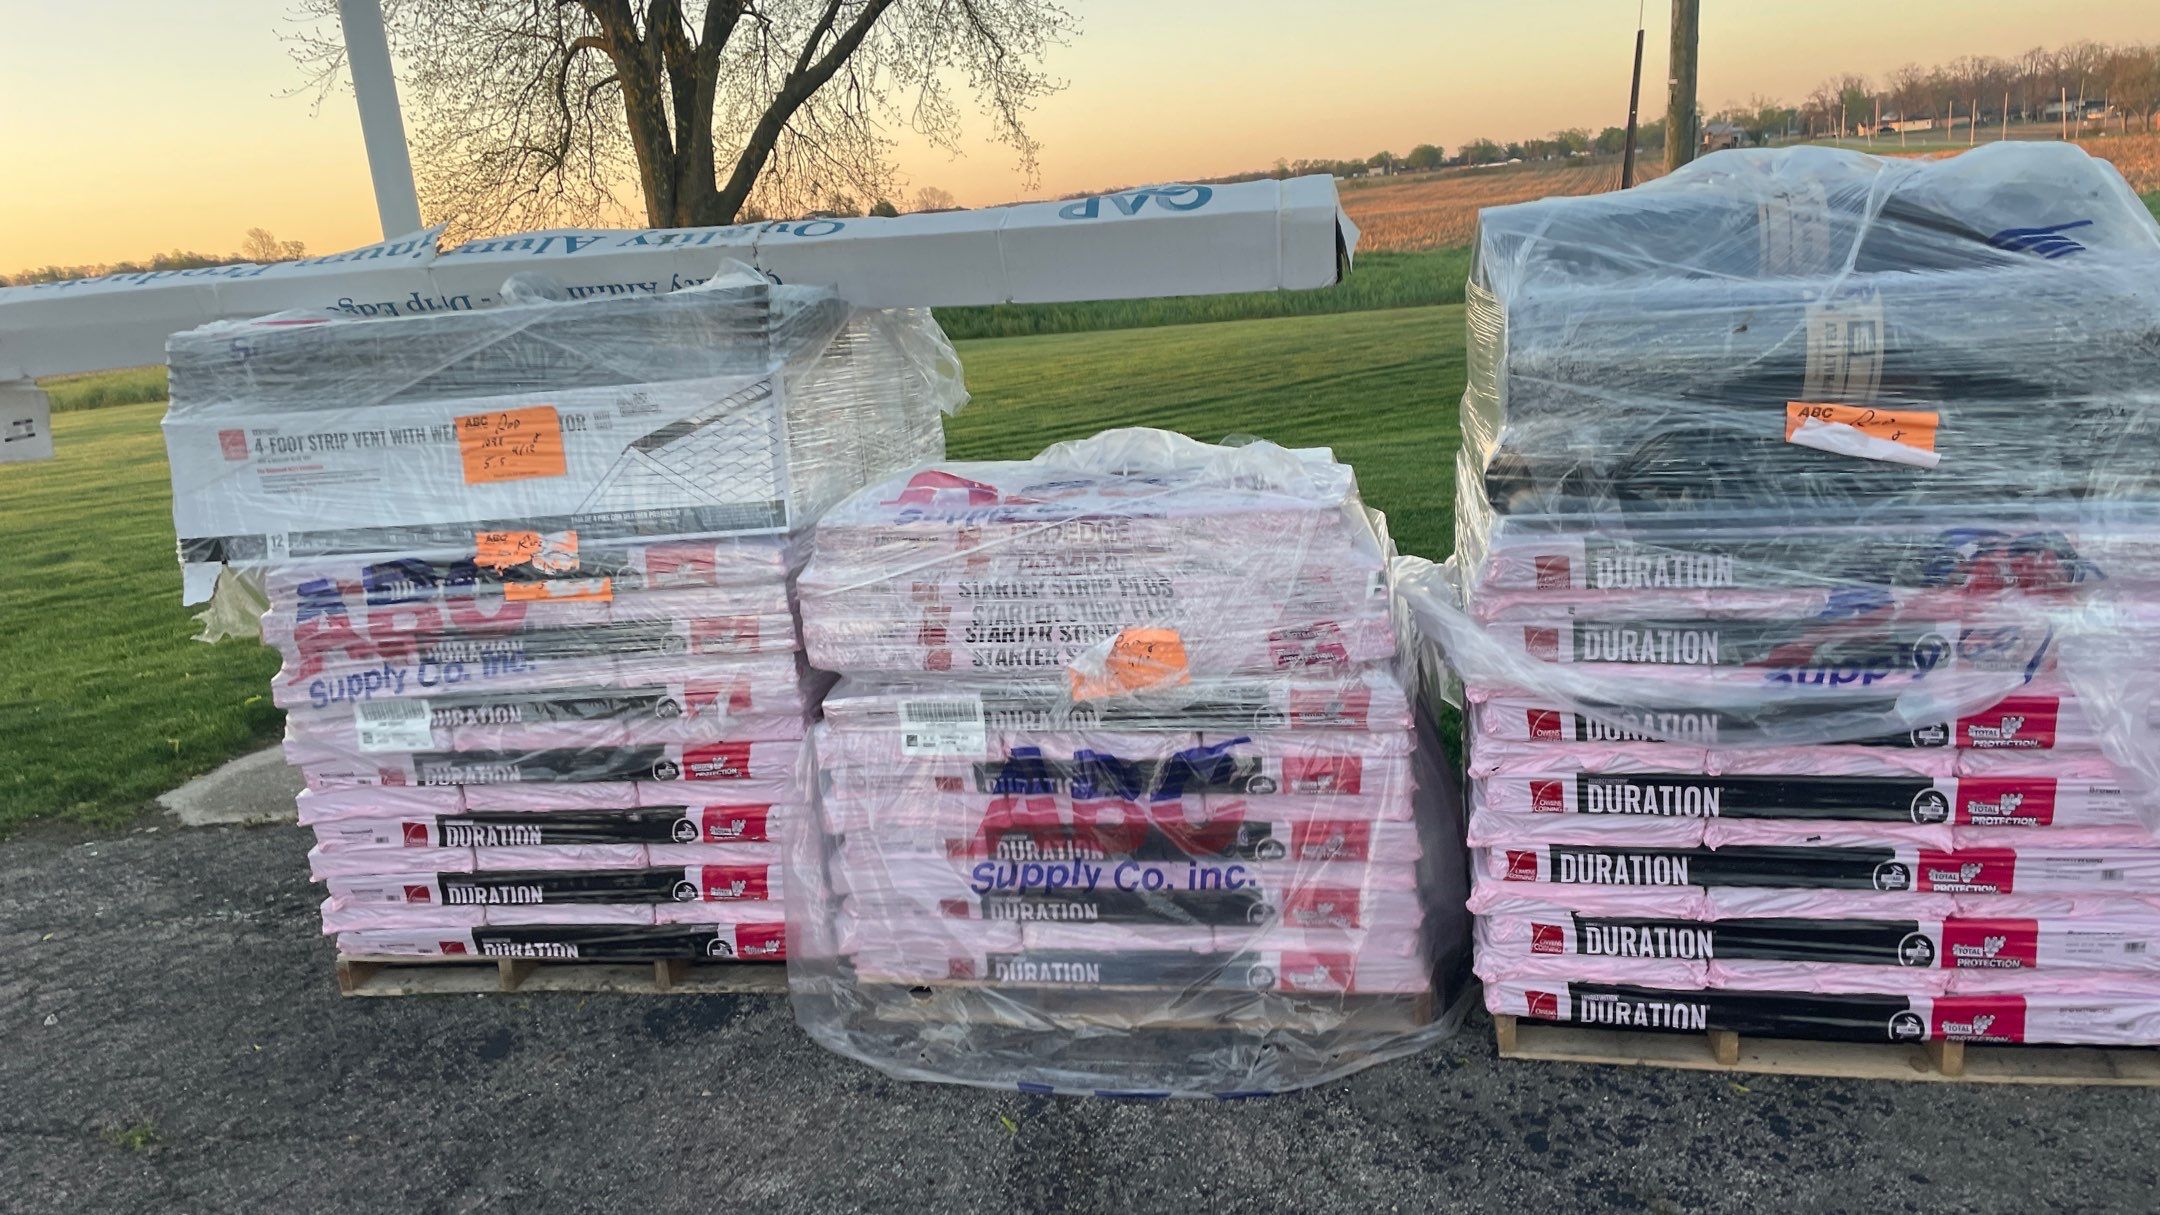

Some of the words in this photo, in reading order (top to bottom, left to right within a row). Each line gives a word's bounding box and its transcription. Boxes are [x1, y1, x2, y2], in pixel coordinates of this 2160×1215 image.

[1059, 185, 1213, 220] QAP
[1798, 406, 1834, 418] ABC
[465, 416, 488, 428] ABC
[307, 432, 349, 452] STRIP
[352, 429, 387, 449] VENT
[389, 427, 426, 446] WITH
[271, 535, 284, 549] 12
[1597, 554, 1733, 589] DURATION
[958, 580, 1045, 598] STARTER
[965, 626, 1053, 643] STARTER
[1583, 630, 1718, 665] DURATION
[971, 649, 1060, 667] STARTER
[308, 660, 408, 709] Supply
[1587, 712, 1719, 742] DURATION
[1975, 729, 1998, 737] TOTAL
[1973, 740, 2039, 749] PROTECTION
[424, 765, 521, 785] DURATION
[969, 737, 1251, 858] ABC
[1587, 784, 1720, 818] DURATION
[1973, 804, 1996, 813] TOTAL
[1971, 816, 2037, 826] PROTECTION
[446, 824, 542, 847] DURATION
[997, 840, 1105, 861] DURATION
[970, 858, 1102, 896] Supply
[1114, 861, 1174, 892] Co.
[1188, 861, 1256, 890] inc.
[1560, 852, 1689, 886] DURATION
[1934, 872, 1958, 881] TOTAL
[448, 885, 544, 904] DURATION
[1933, 884, 1998, 894] PROTECTION
[990, 902, 1099, 921] DURATION
[482, 942, 579, 958] DURATION
[1585, 926, 1714, 959] DURATION
[1957, 947, 1981, 956] TOTAL
[1957, 958, 2022, 968] PROTECTION
[995, 963, 1100, 984] DURATION
[1581, 1000, 1707, 1030] DURATION
[1947, 1024, 1971, 1033] TOTAL
